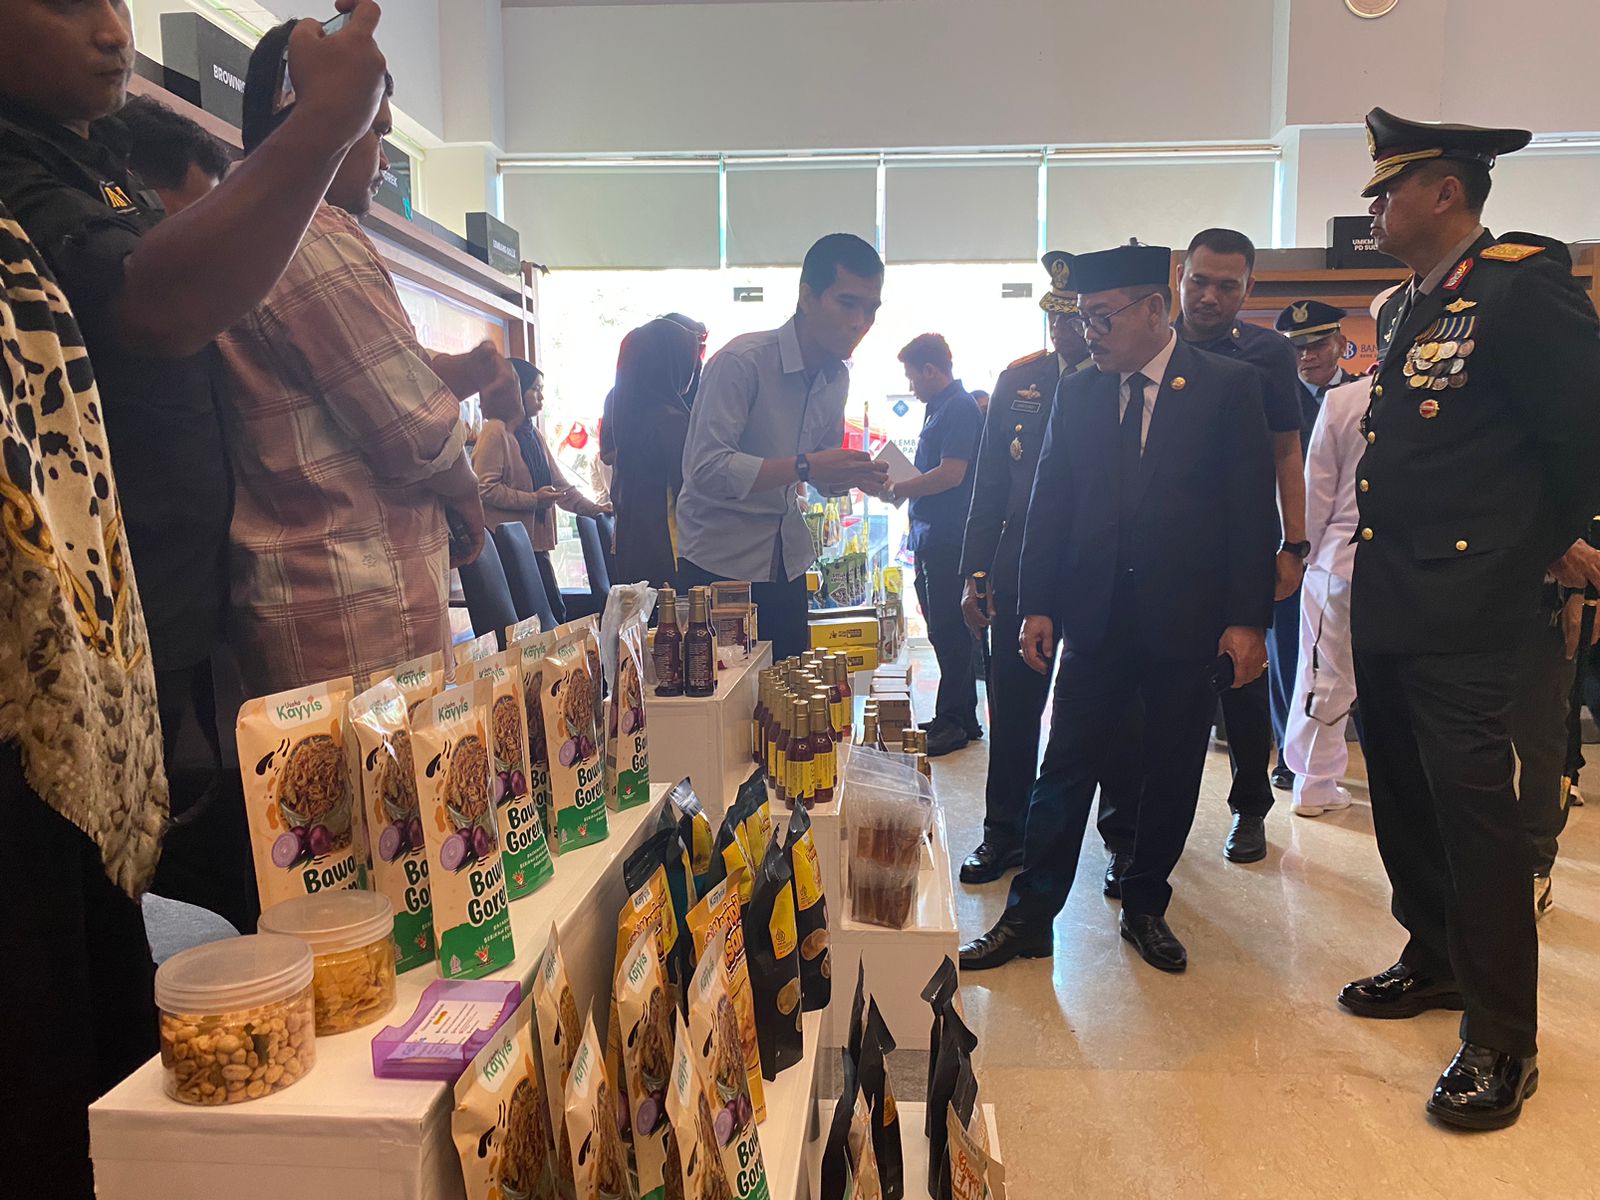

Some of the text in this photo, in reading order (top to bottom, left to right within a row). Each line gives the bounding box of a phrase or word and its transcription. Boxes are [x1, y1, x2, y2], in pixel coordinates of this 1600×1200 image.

[397, 670, 426, 686] Kayyis
[276, 698, 323, 721] Kayyis
[438, 702, 469, 722] Kayyis
[404, 886, 430, 913] Go
[629, 952, 648, 986] Kayyis
[483, 1039, 513, 1082] Kayyis
